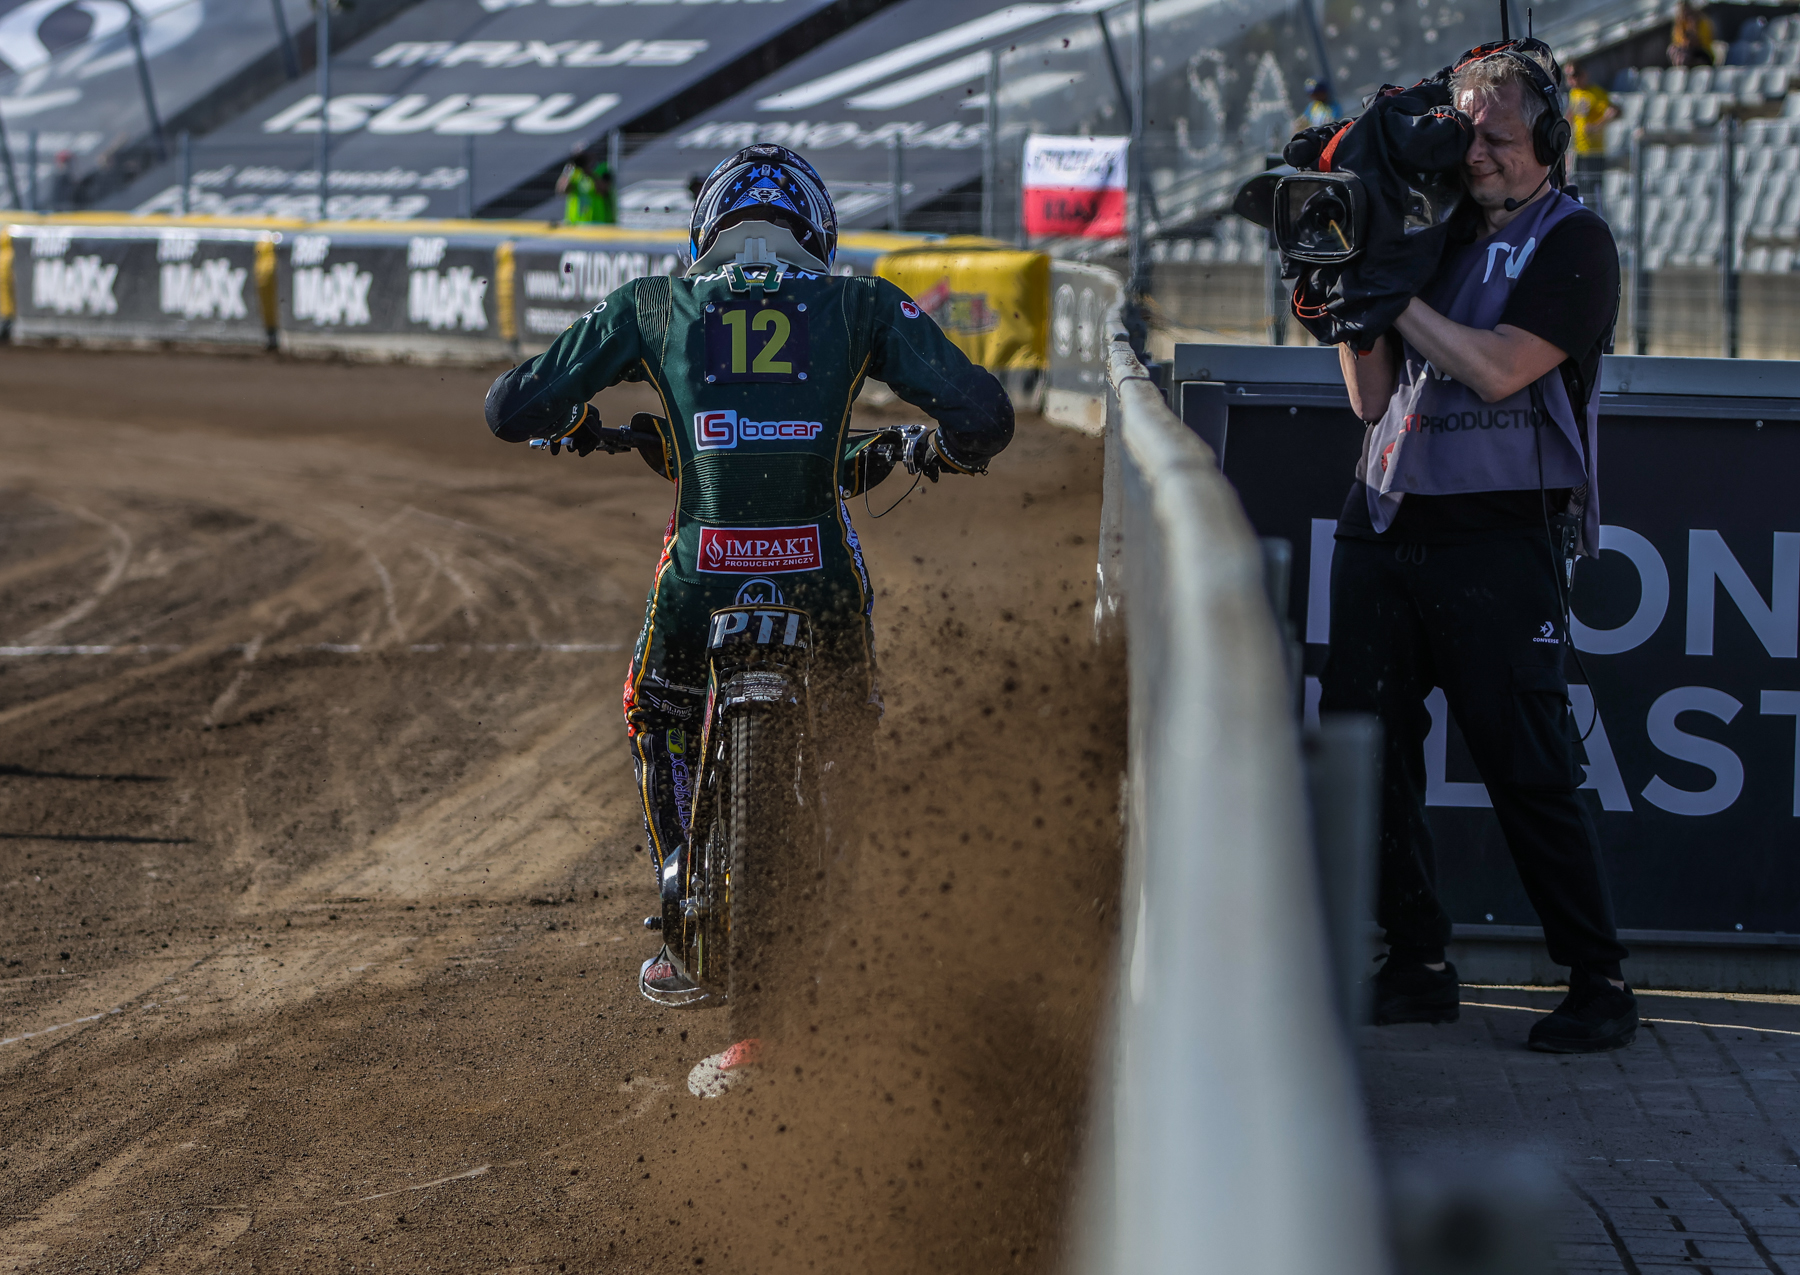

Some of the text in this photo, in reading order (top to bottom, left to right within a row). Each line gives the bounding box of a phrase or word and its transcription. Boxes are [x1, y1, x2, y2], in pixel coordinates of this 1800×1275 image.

[263, 93, 621, 134] ISUZU
[1483, 237, 1536, 284] TV
[722, 309, 793, 374] 12
[741, 419, 821, 438] bocar
[725, 537, 813, 557] IMPAKT
[725, 557, 814, 568] PRODUCENT ZNICZY
